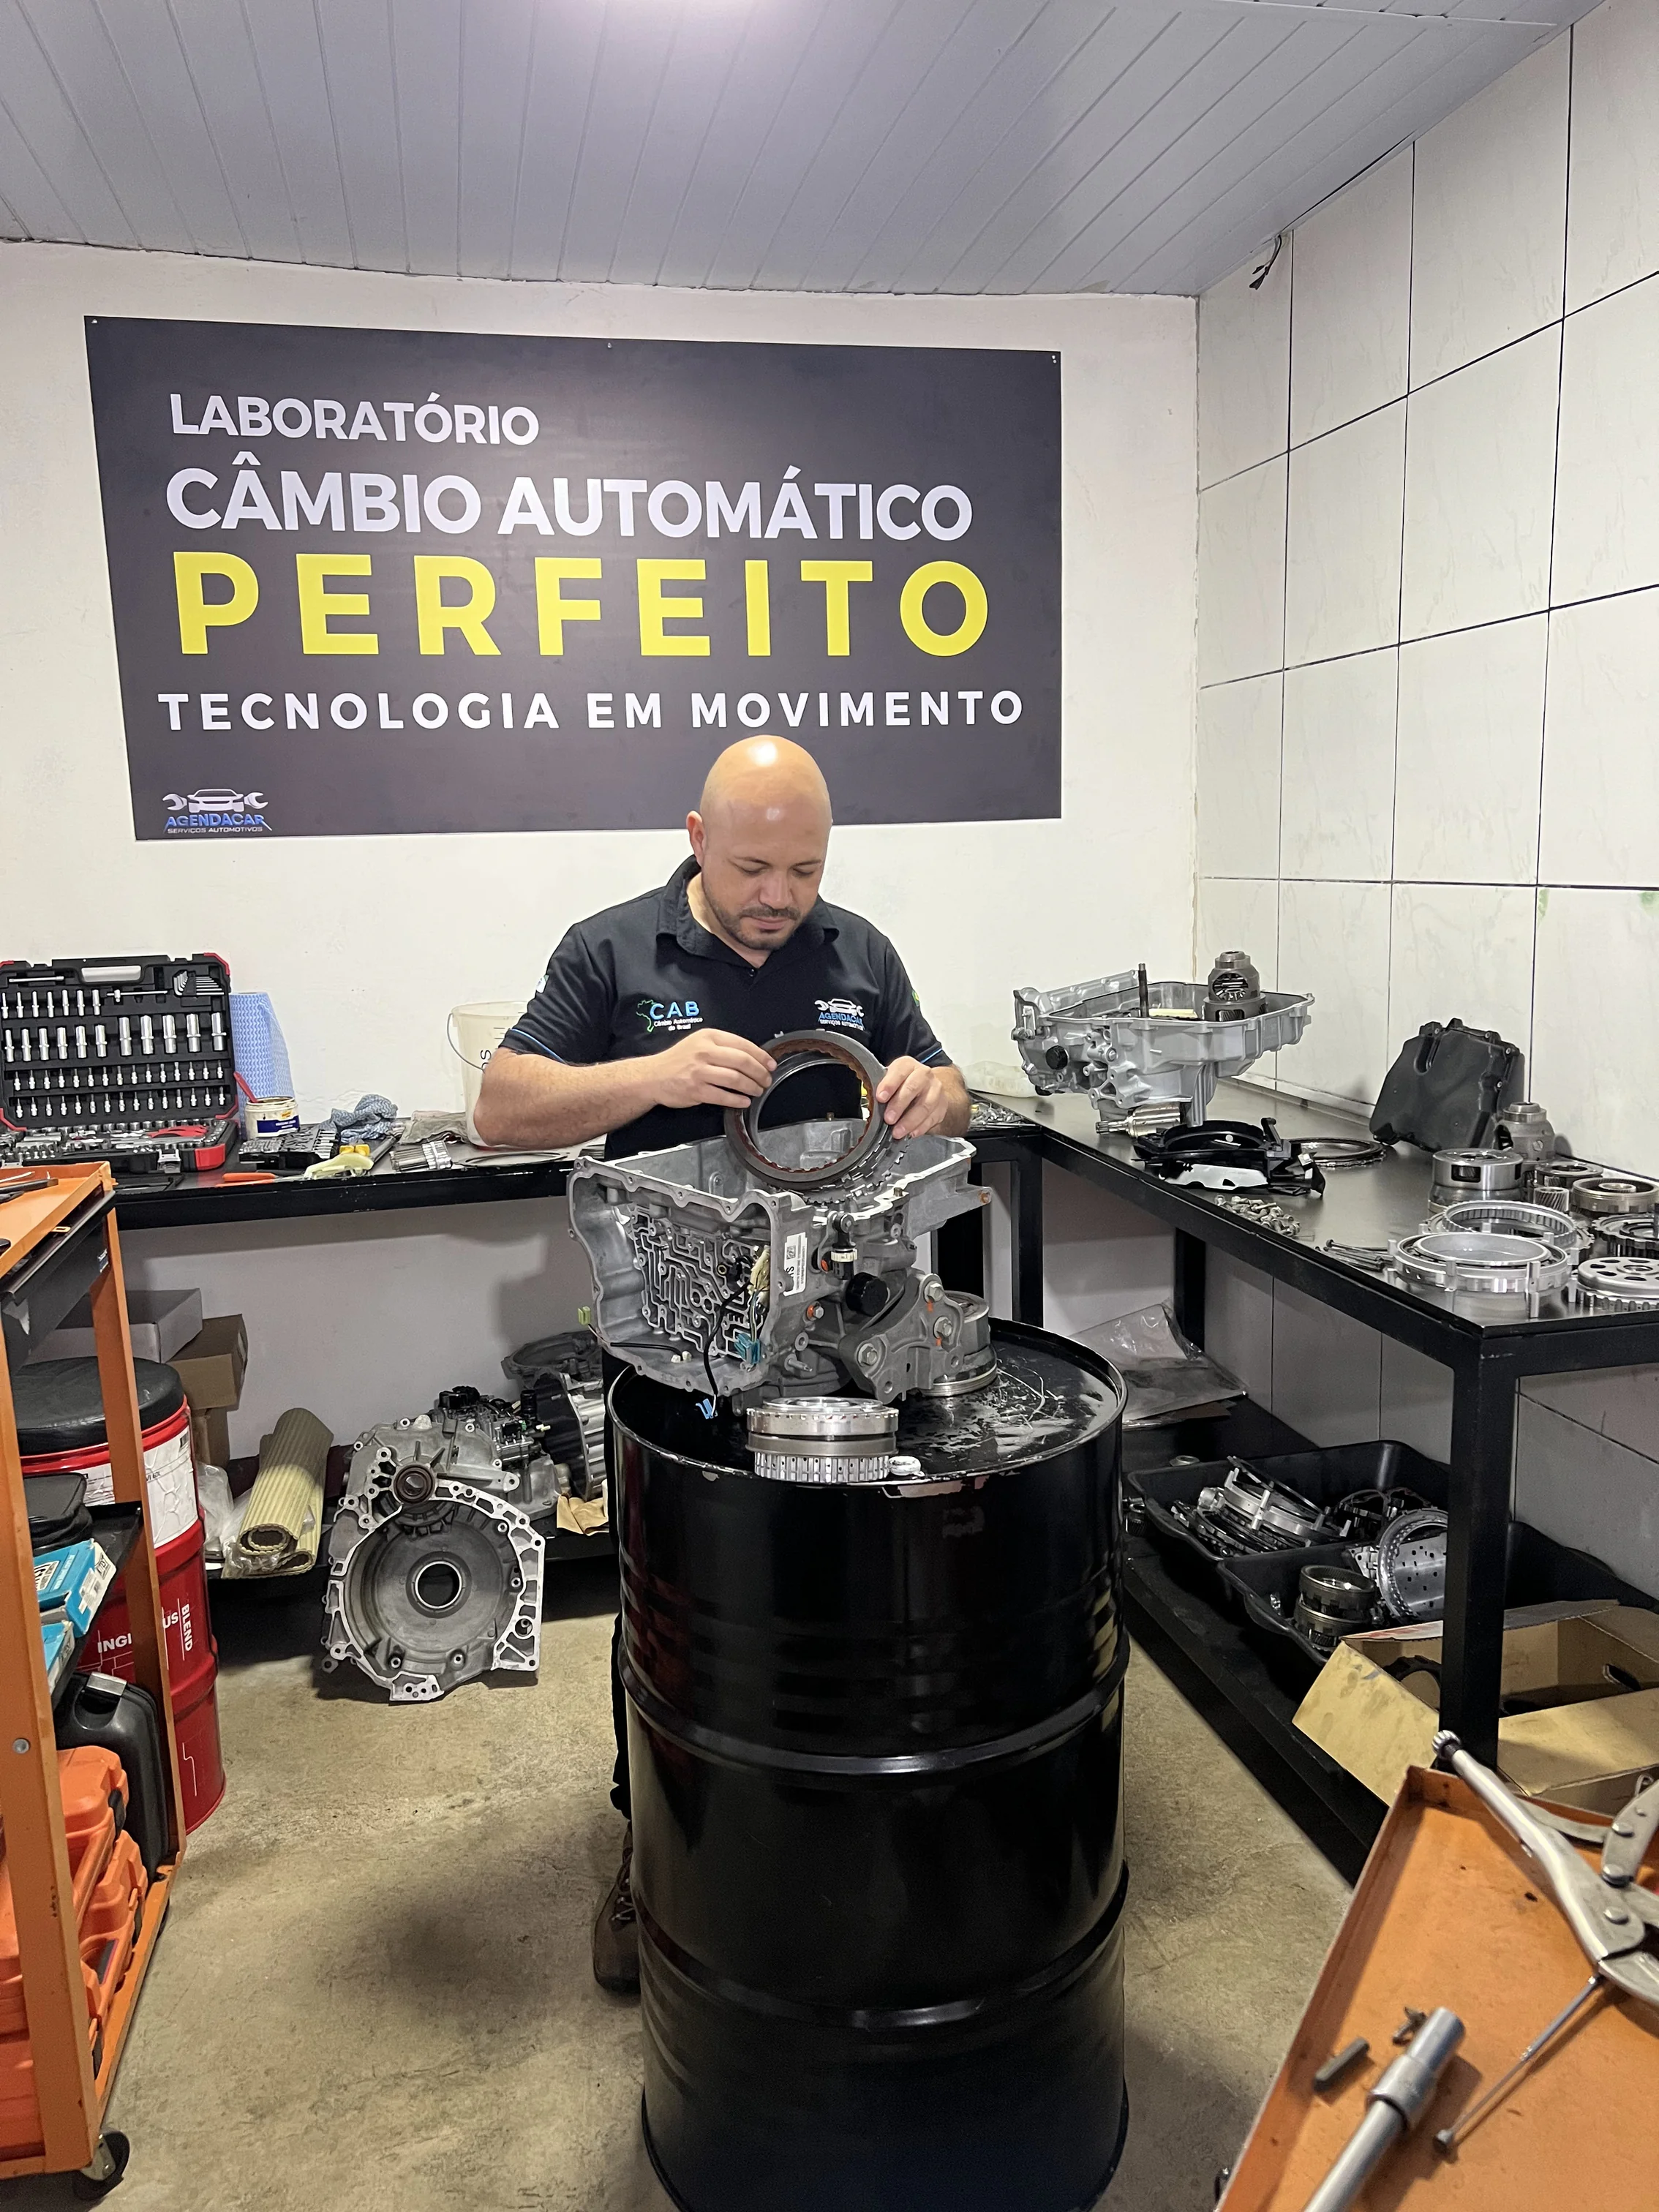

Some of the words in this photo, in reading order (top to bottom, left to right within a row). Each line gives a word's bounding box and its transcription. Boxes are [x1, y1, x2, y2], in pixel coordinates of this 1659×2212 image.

[170, 391, 540, 446] LABORATÓRIO
[166, 451, 482, 535] CÂMBIO
[497, 465, 973, 541] AUTOMÁTICO
[173, 551, 988, 657] PERFEITO
[157, 692, 560, 731] TECNOLOGIA
[587, 693, 662, 729] EM
[691, 690, 1023, 728] MOVIMENTO
[165, 813, 272, 832] AGENDACAR
[650, 1001, 700, 1020] CAB
[181, 1603, 193, 1652] BLEND
